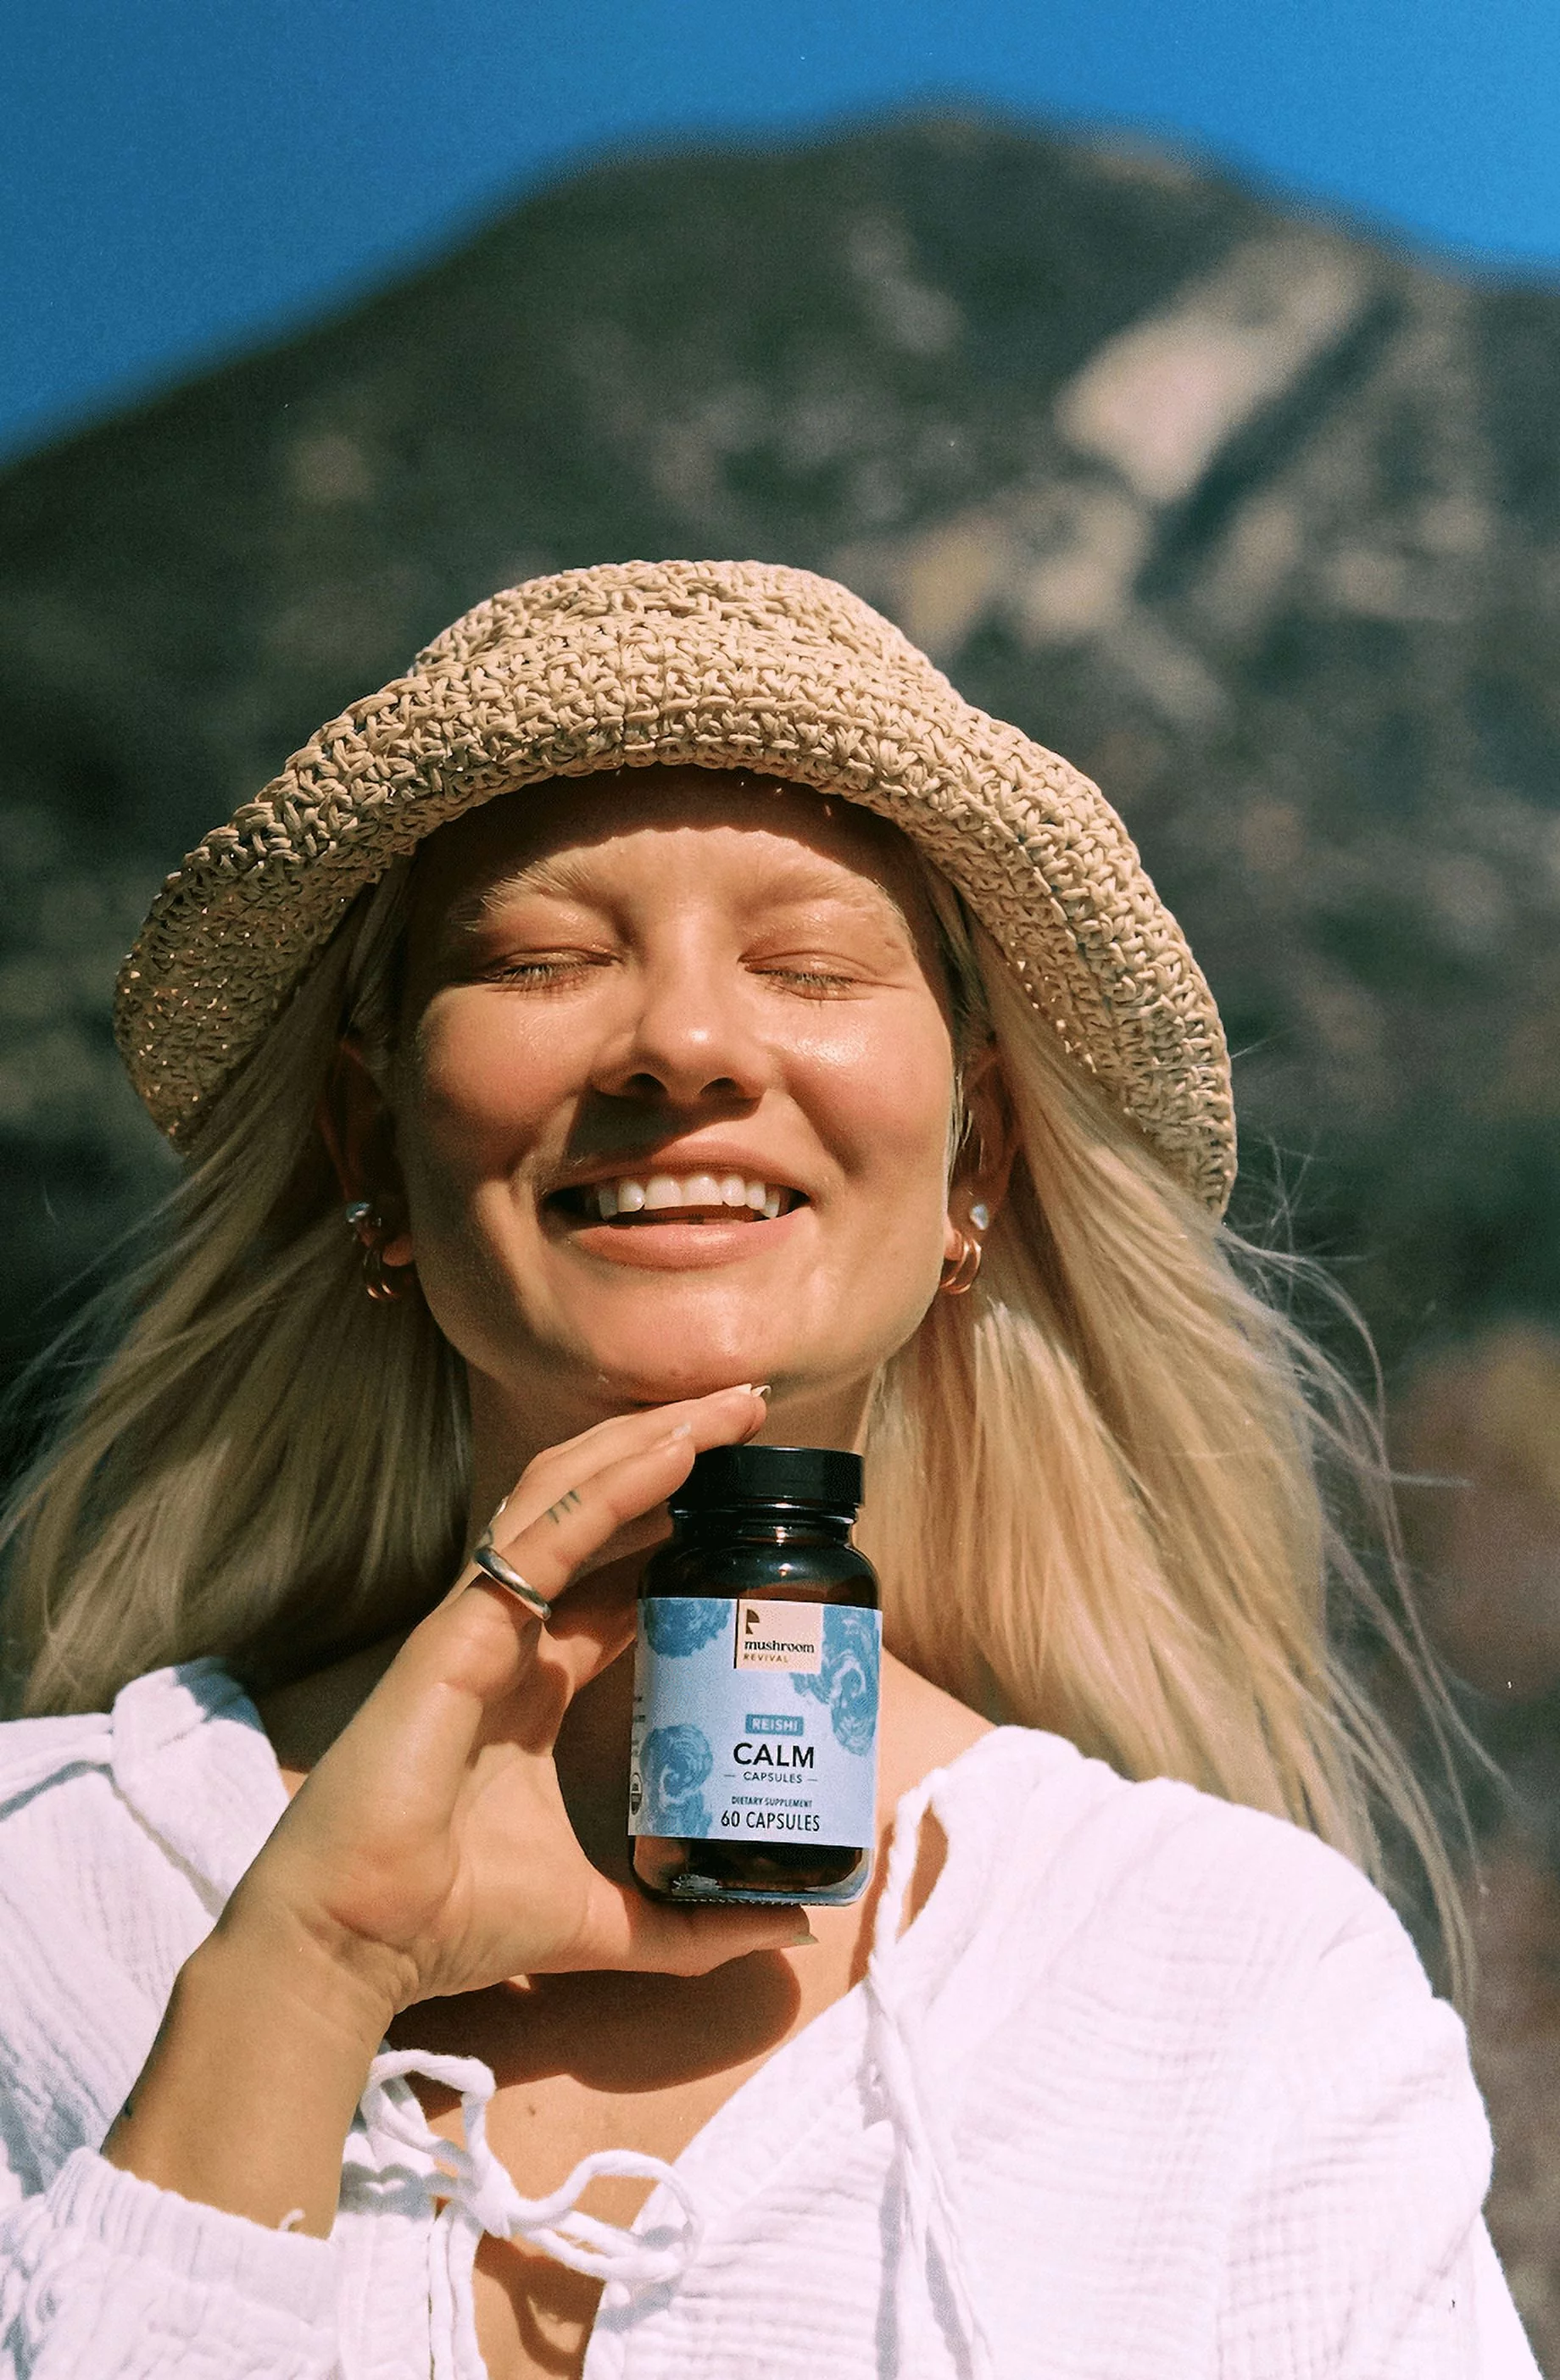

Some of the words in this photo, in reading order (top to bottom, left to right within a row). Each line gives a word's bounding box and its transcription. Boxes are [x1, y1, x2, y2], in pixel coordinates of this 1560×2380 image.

[744, 1640, 815, 1654] mushroom
[744, 1654, 788, 1663] REVIVAL
[751, 1718, 798, 1732] REISHI
[733, 1742, 814, 1769] CALM
[743, 1771, 803, 1783] CAPSULES
[732, 1796, 763, 1805] DIETARY
[765, 1798, 812, 1808] SUPPLEMENT
[721, 1810, 740, 1827] 60
[746, 1811, 820, 1832] CAPSULES
